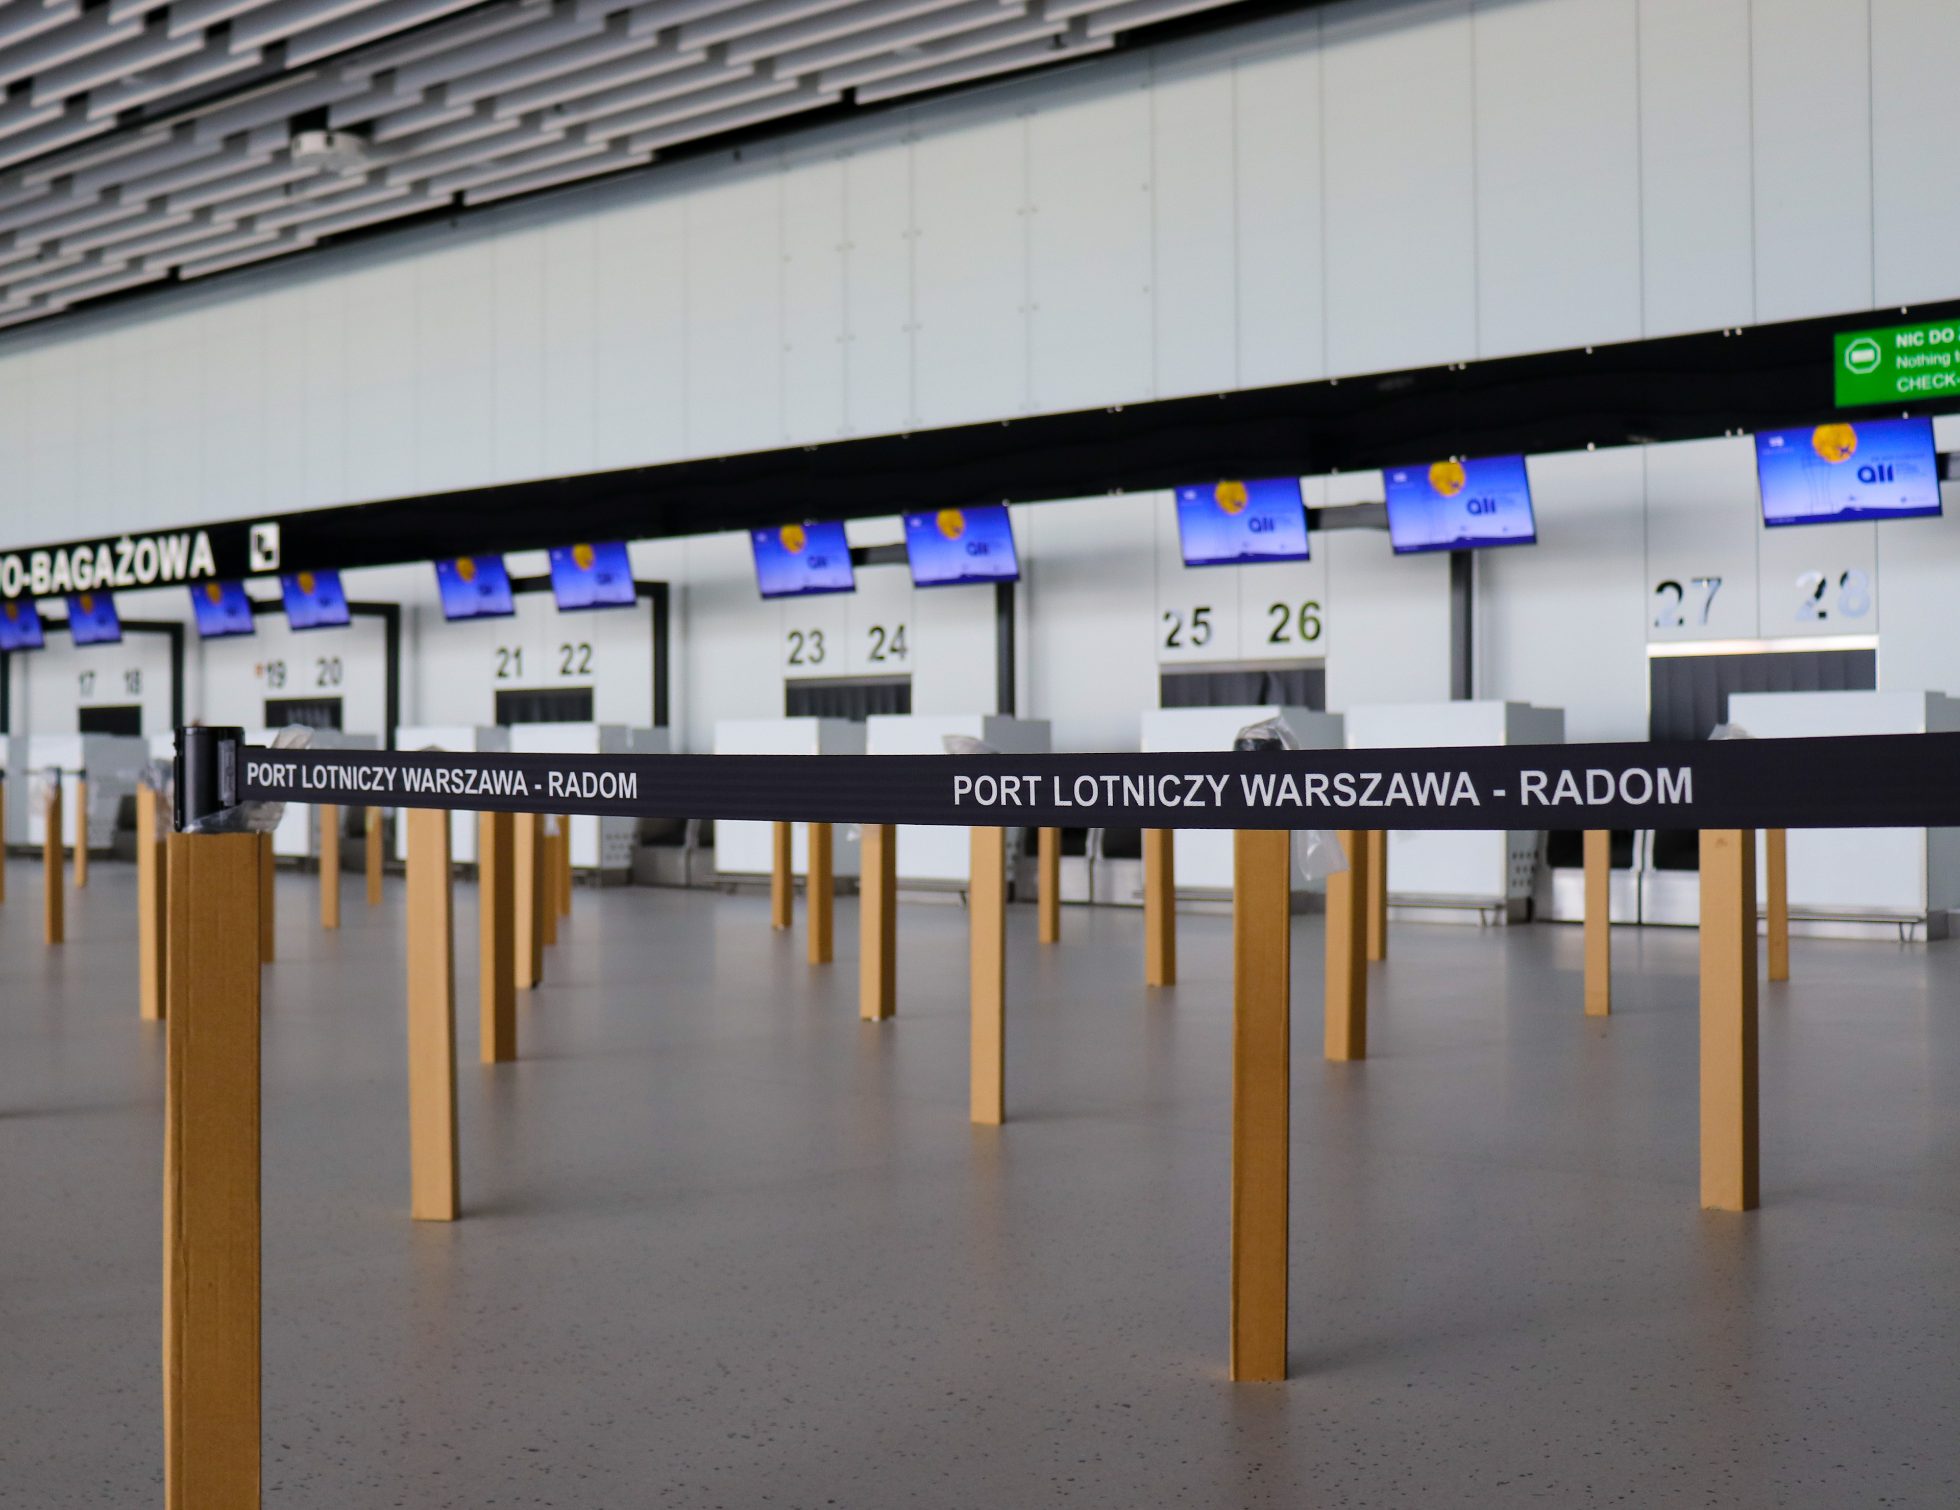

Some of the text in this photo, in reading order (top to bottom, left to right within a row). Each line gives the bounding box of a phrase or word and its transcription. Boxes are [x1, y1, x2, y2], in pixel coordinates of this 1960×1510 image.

[1896, 328, 1955, 348] NIC DO
[1896, 352, 1951, 369] Nothing
[0, 530, 216, 598] O-BAGAŻOWA
[1655, 576, 1721, 627] 27
[1796, 568, 1870, 621] 28
[1163, 607, 1212, 648] 25
[1268, 601, 1322, 643] 26
[559, 643, 592, 675] 22
[787, 630, 825, 665] 23
[868, 624, 907, 661] 24
[266, 660, 286, 688] 19
[316, 656, 342, 687] 20
[496, 648, 523, 678] 21
[247, 762, 297, 788] PORT
[302, 765, 397, 791] LOTNICZY
[401, 768, 528, 796] WARSZAWA
[548, 771, 637, 799] RADOM
[953, 775, 1042, 806] PORT
[1054, 774, 1230, 807] LOTNICZY
[1240, 772, 1481, 807] WARSZAWA
[1520, 767, 1693, 805] RADOM
